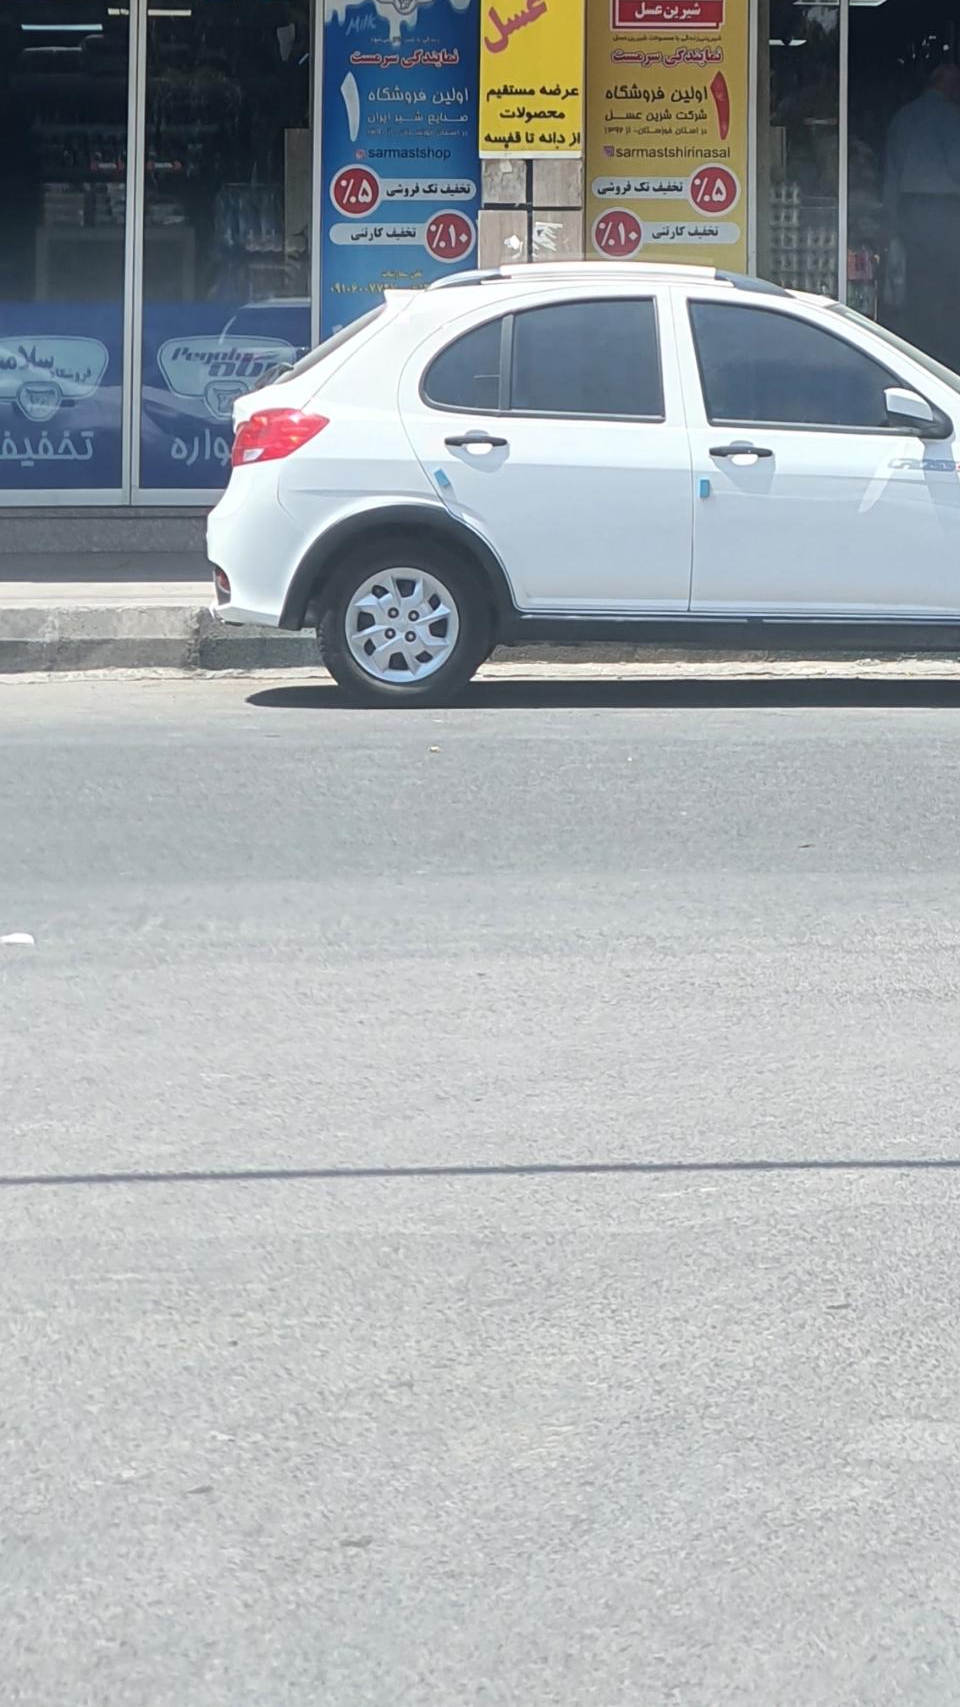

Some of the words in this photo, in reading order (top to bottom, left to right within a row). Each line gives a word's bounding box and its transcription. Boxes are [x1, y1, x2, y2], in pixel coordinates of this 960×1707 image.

[634, 2, 663, 19] عسل
[663, 2, 701, 20] شیرین
[368, 86, 427, 104] فروشگاه
[432, 87, 469, 104] اولین
[486, 85, 535, 102] مستقیم
[539, 84, 580, 100] عرضه
[605, 84, 665, 102] فروشگاه
[671, 86, 708, 103] اولین
[500, 106, 566, 123] محصولات
[675, 109, 708, 122] شرکت
[525, 132, 535, 143] تا
[368, 147, 451, 159] sarmastshop
[616, 146, 731, 158] sarmastshirinasal
[386, 182, 420, 197] فروشی
[440, 183, 471, 196] تخفیف
[597, 181, 632, 195] فروشی
[652, 182, 683, 195] تخفیف
[386, 227, 416, 240] تخفیف
[688, 225, 719, 238] تخفیف
[171, 347, 242, 365] Pegah
